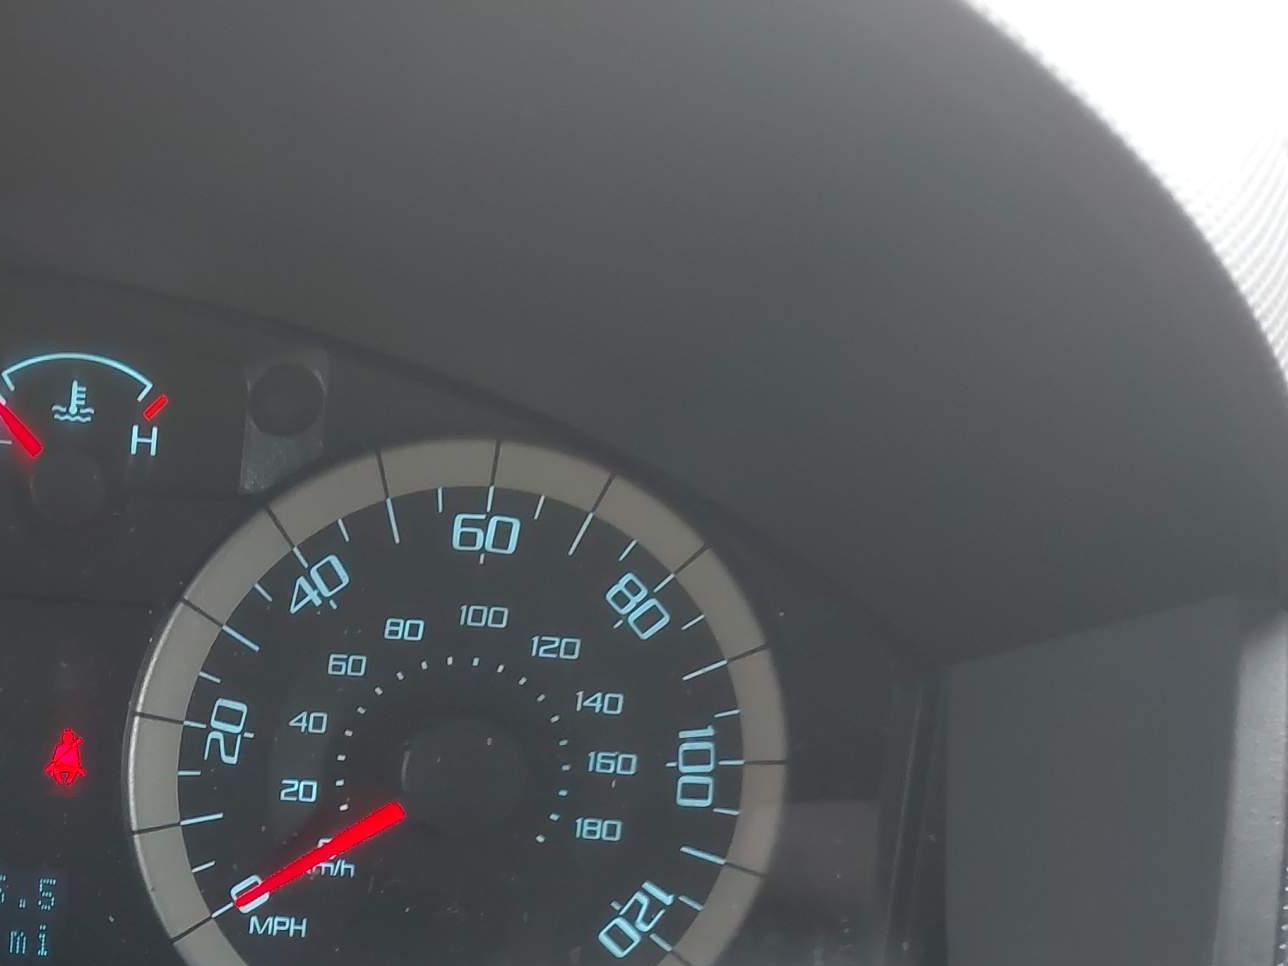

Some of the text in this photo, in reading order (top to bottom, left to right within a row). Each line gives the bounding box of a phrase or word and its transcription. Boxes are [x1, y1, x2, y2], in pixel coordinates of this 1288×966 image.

[131, 425, 158, 456] H
[452, 514, 520, 555] 60
[290, 554, 349, 613] 40
[459, 605, 508, 628] 100
[605, 572, 669, 640] 80
[384, 618, 424, 641] 80
[530, 636, 581, 660] 120
[327, 654, 367, 678] 60
[575, 691, 624, 714] 140
[204, 698, 248, 764] 20
[288, 712, 328, 735] 40
[587, 752, 637, 776] 160
[676, 726, 715, 808] 100
[280, 780, 318, 803] 20
[575, 818, 622, 842] 180
[249, 916, 307, 938] MPH
[598, 881, 674, 958] 120
[10, 925, 48, 957] mi
